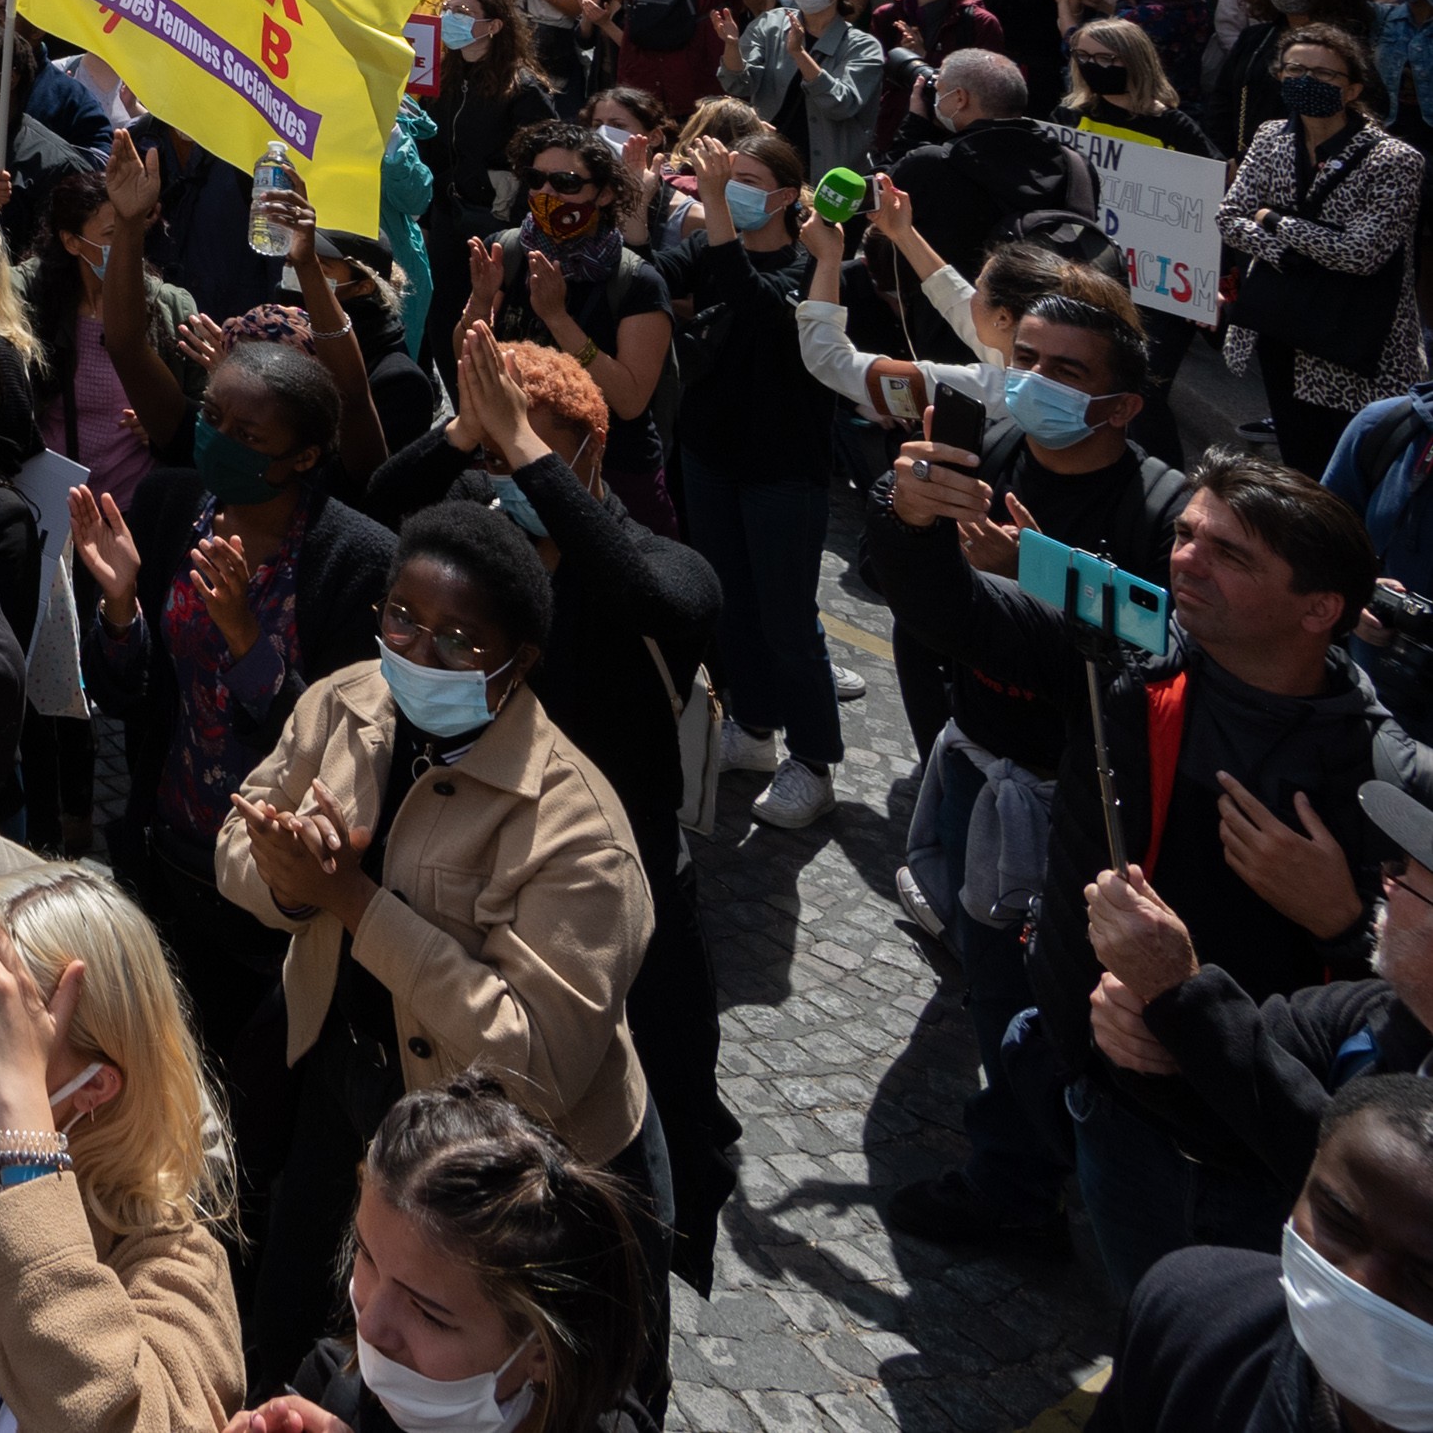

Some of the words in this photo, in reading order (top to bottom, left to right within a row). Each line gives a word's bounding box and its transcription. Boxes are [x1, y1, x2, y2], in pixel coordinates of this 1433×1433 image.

[154, 2, 221, 71] Femmes
[221, 48, 308, 146] Socialistes
[1126, 247, 1217, 313] ACISM
